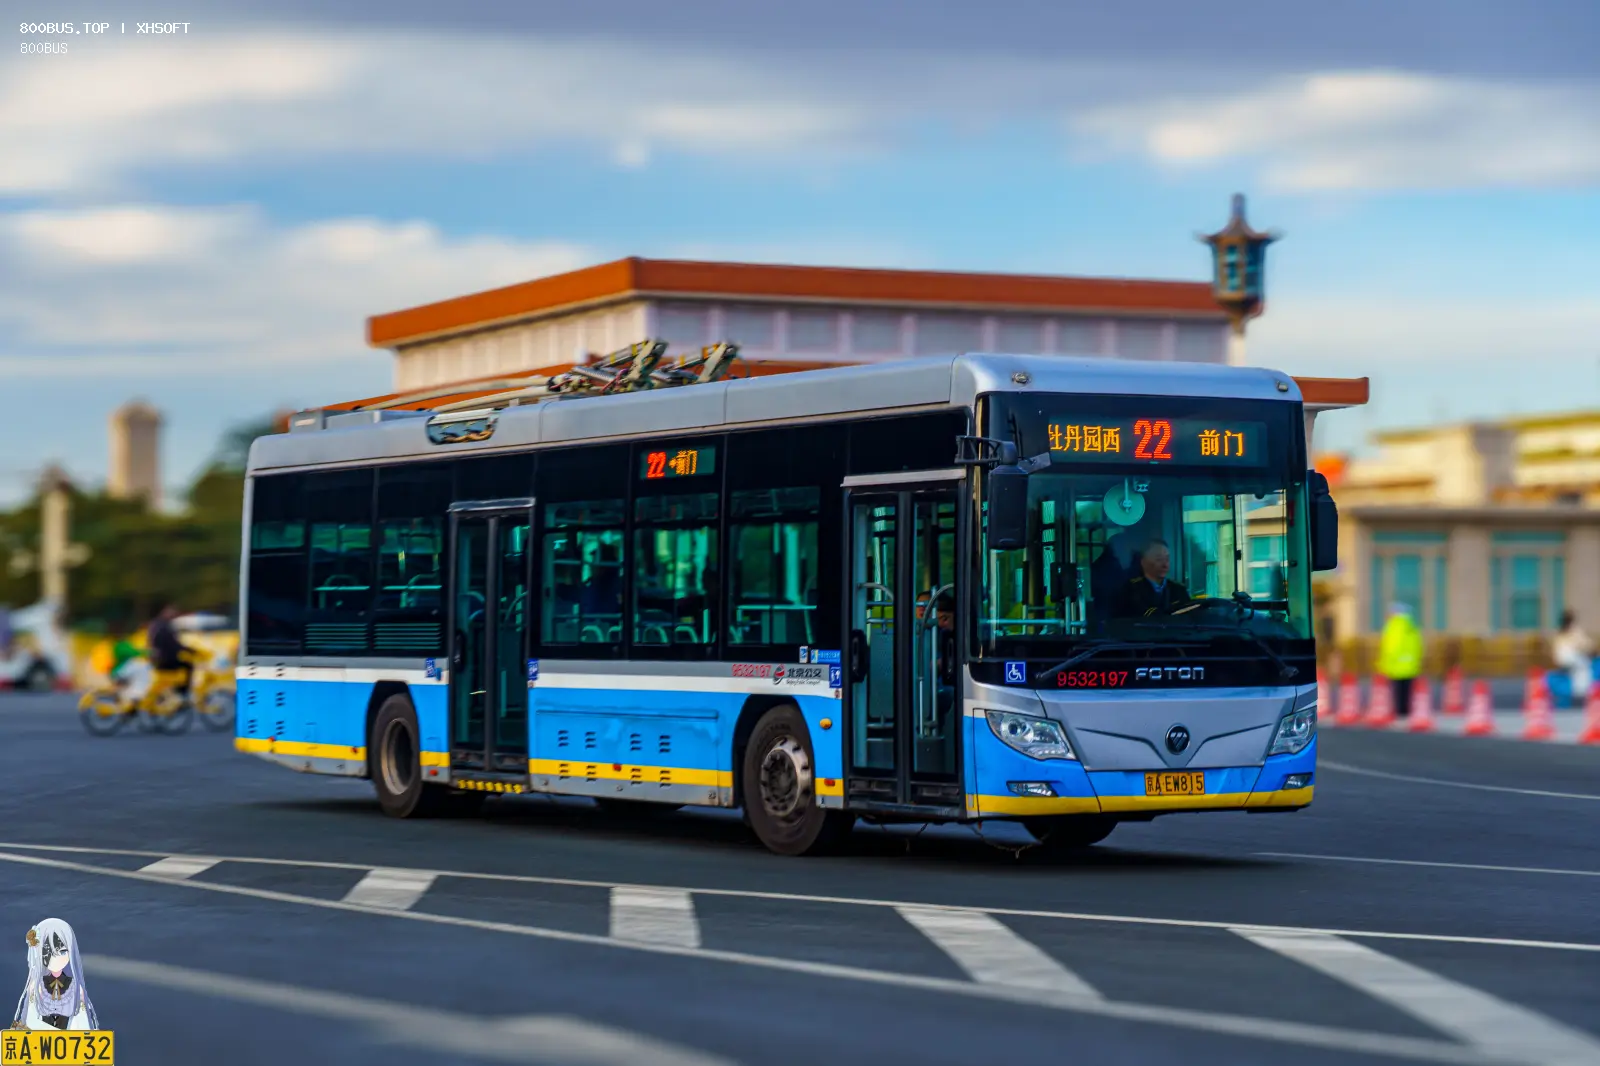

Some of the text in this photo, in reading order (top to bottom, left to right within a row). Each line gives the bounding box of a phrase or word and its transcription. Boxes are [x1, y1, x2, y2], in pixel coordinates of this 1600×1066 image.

[1134, 419, 1172, 459] 22
[1199, 429, 1244, 457] 前门
[647, 451, 667, 478] 22
[732, 663, 771, 678] 9532197
[787, 667, 822, 679] 北京公交
[1135, 666, 1204, 680] FOTON
[1057, 671, 1128, 687] 9532197
